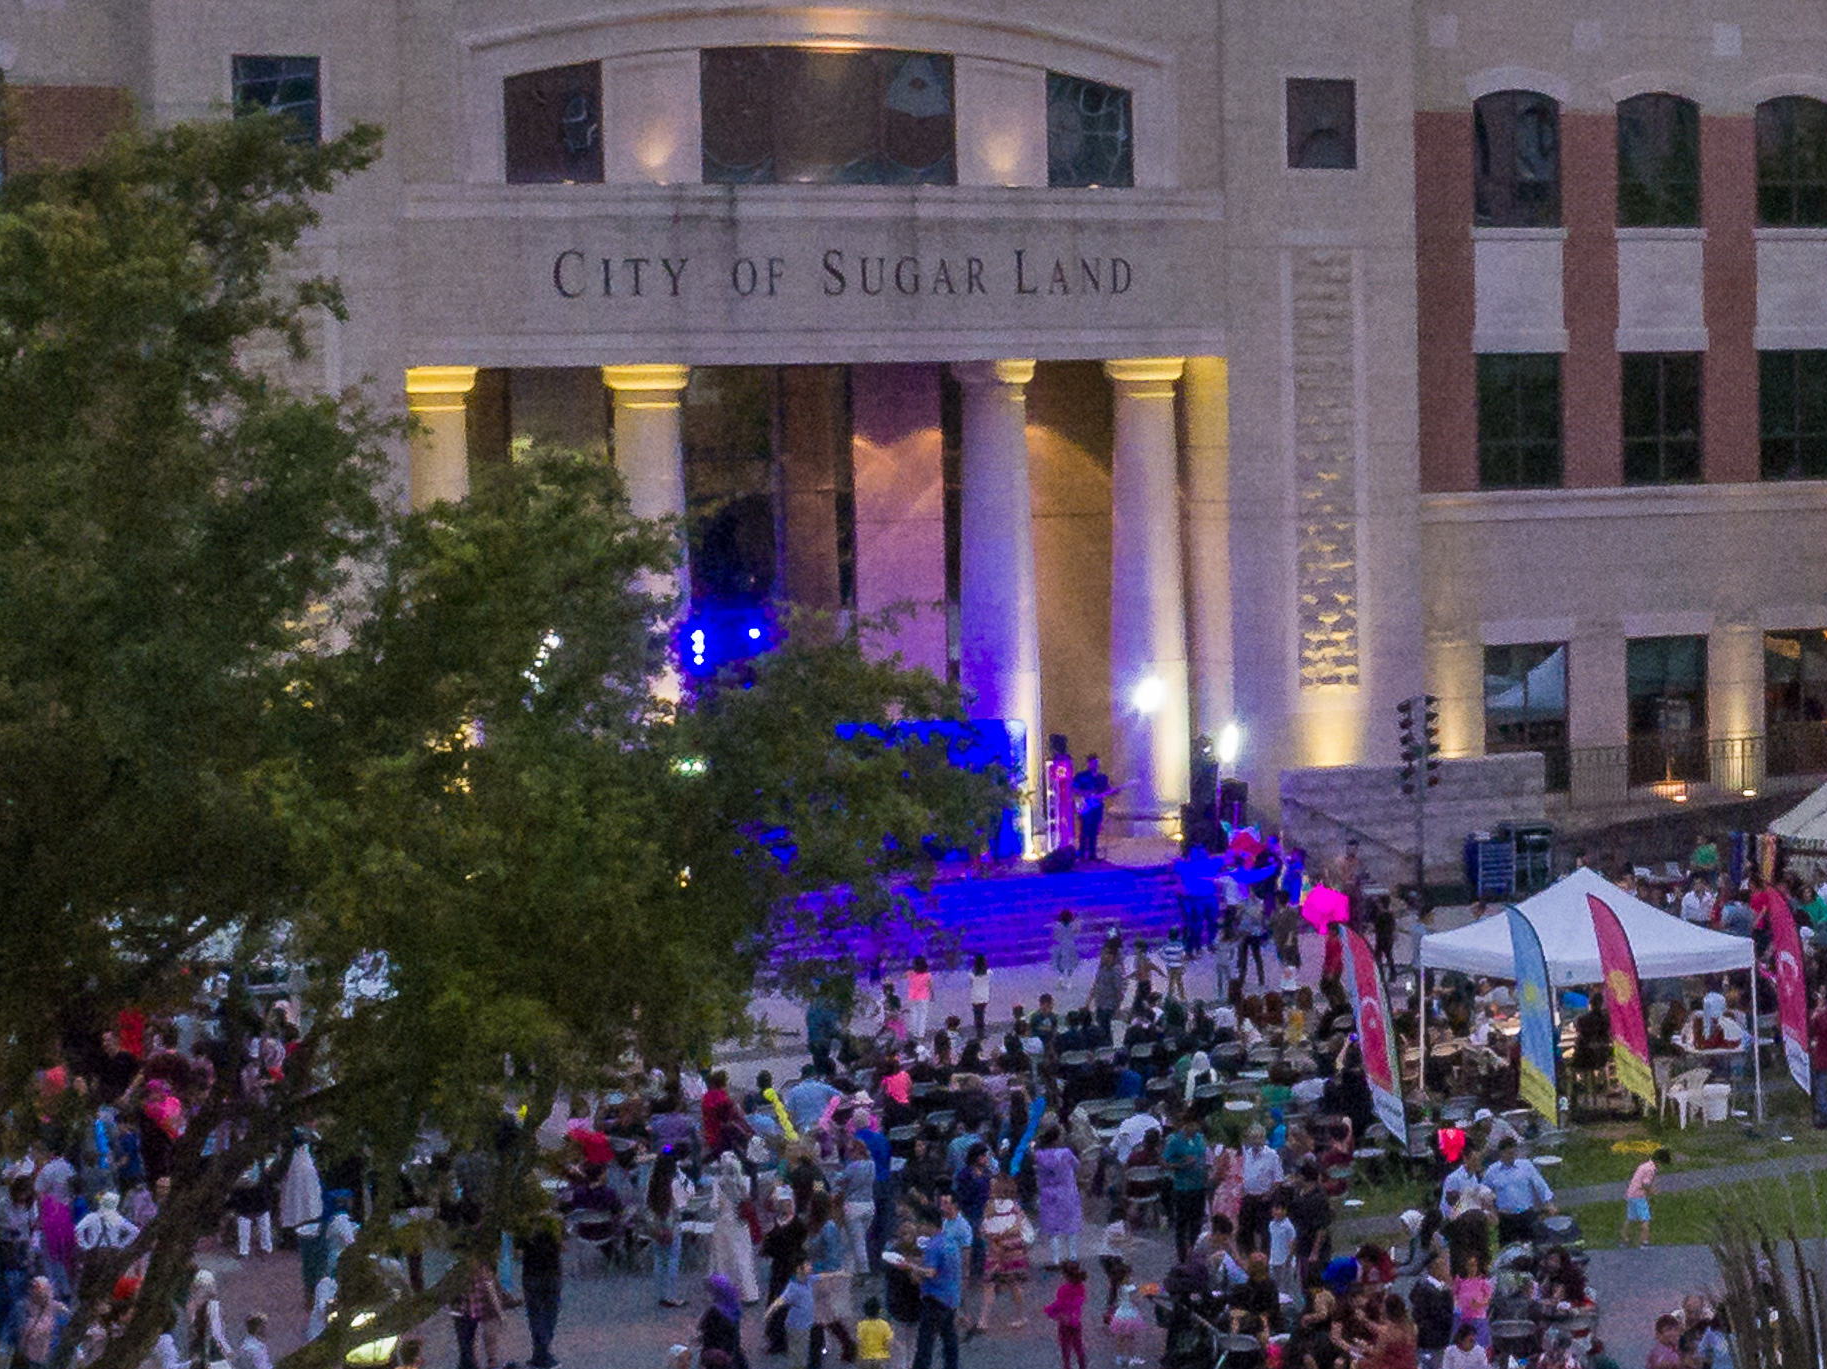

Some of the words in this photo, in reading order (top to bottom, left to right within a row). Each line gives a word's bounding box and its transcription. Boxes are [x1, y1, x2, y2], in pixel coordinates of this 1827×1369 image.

[553, 248, 689, 300] CITY
[732, 256, 786, 298] OF
[822, 249, 988, 298] SUGAR
[1013, 248, 1135, 296] LAND
